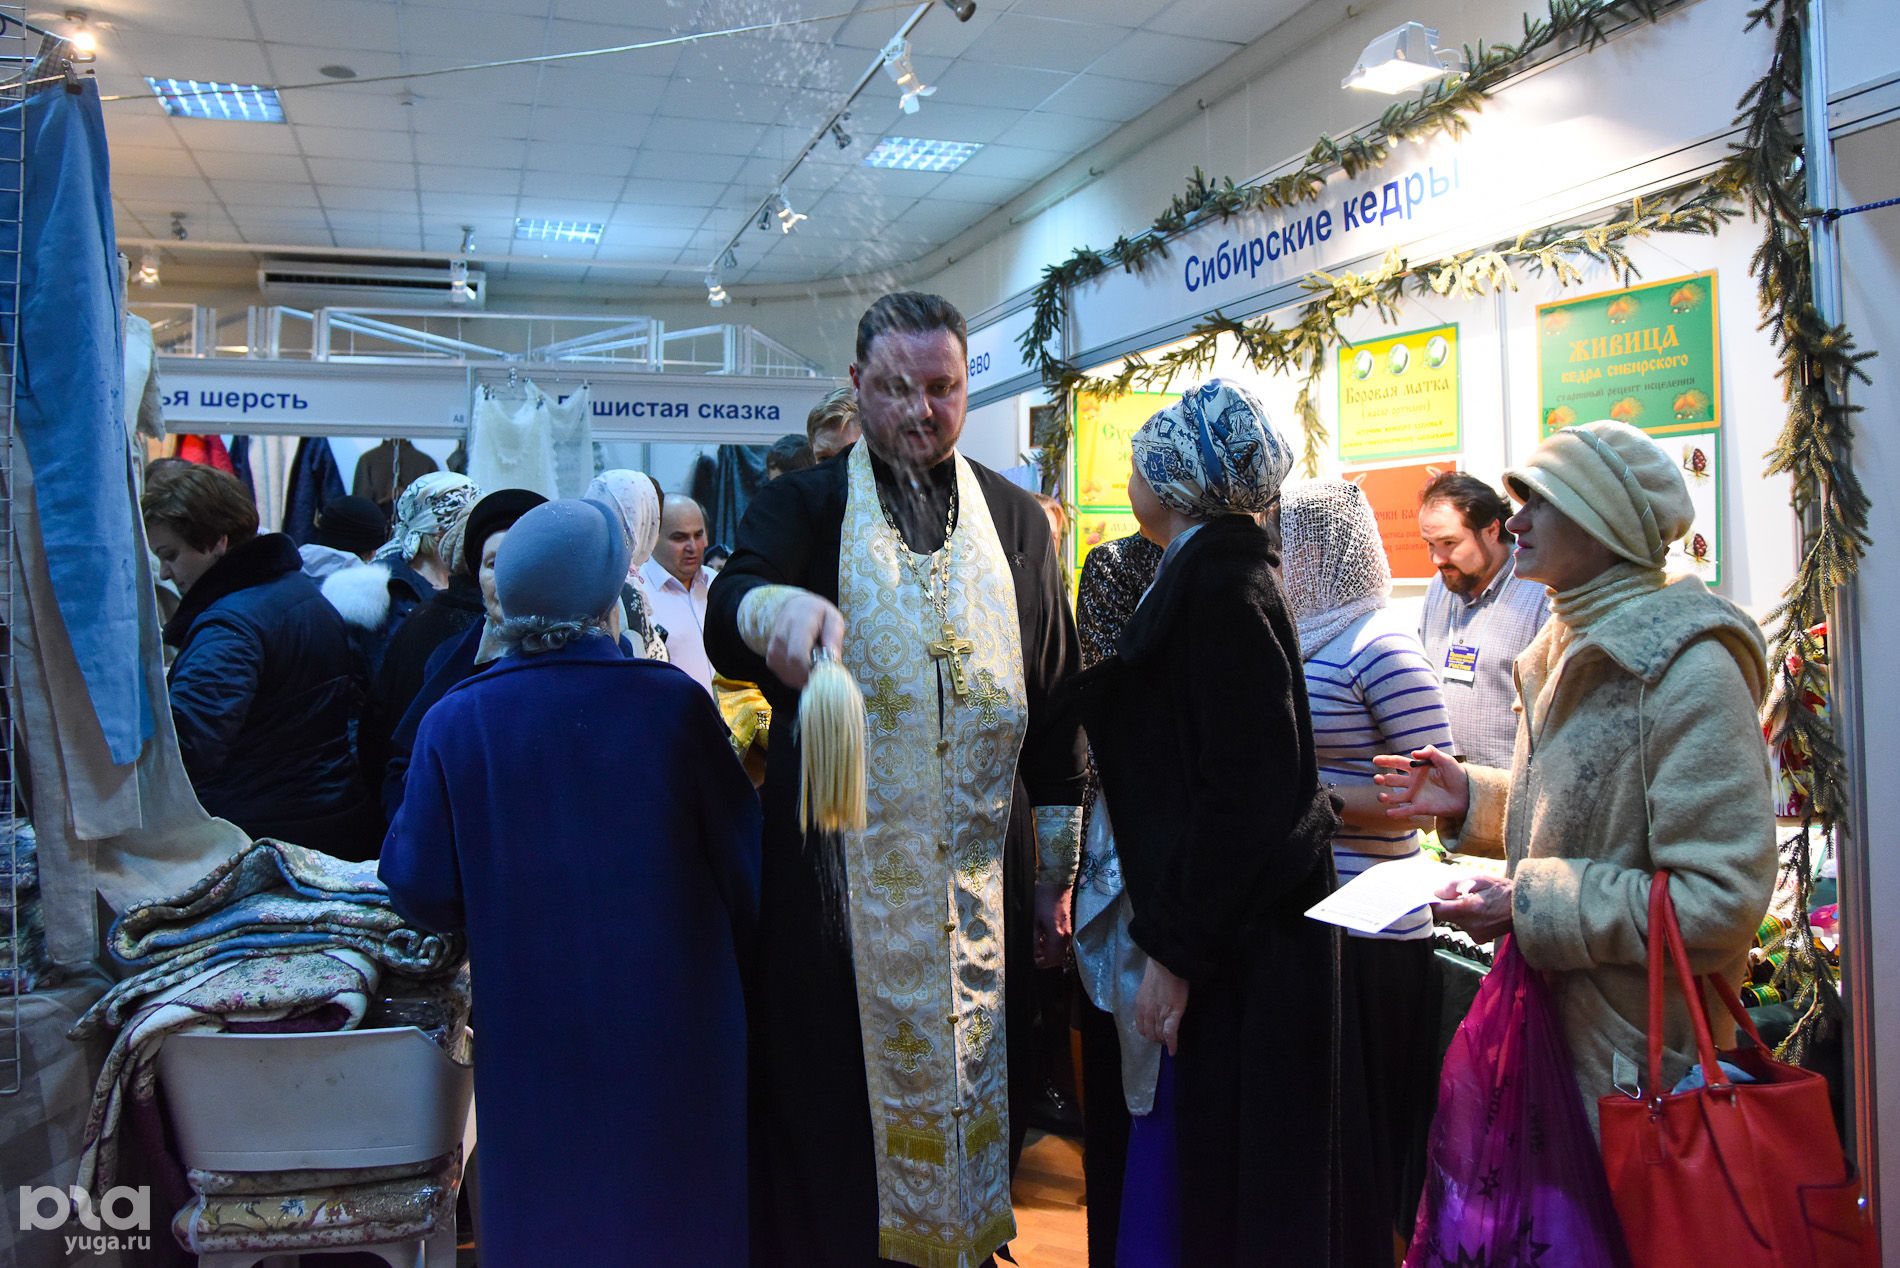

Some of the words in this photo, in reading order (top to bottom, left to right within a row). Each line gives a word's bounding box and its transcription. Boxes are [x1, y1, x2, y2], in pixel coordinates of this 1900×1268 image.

[1184, 209, 1333, 292] Сибирские
[1343, 157, 1460, 232] кедры
[1568, 324, 1680, 363] ЖИВИЦА
[968, 352, 990, 376] ево
[200, 391, 308, 413] шерсть
[698, 401, 781, 421] сказка
